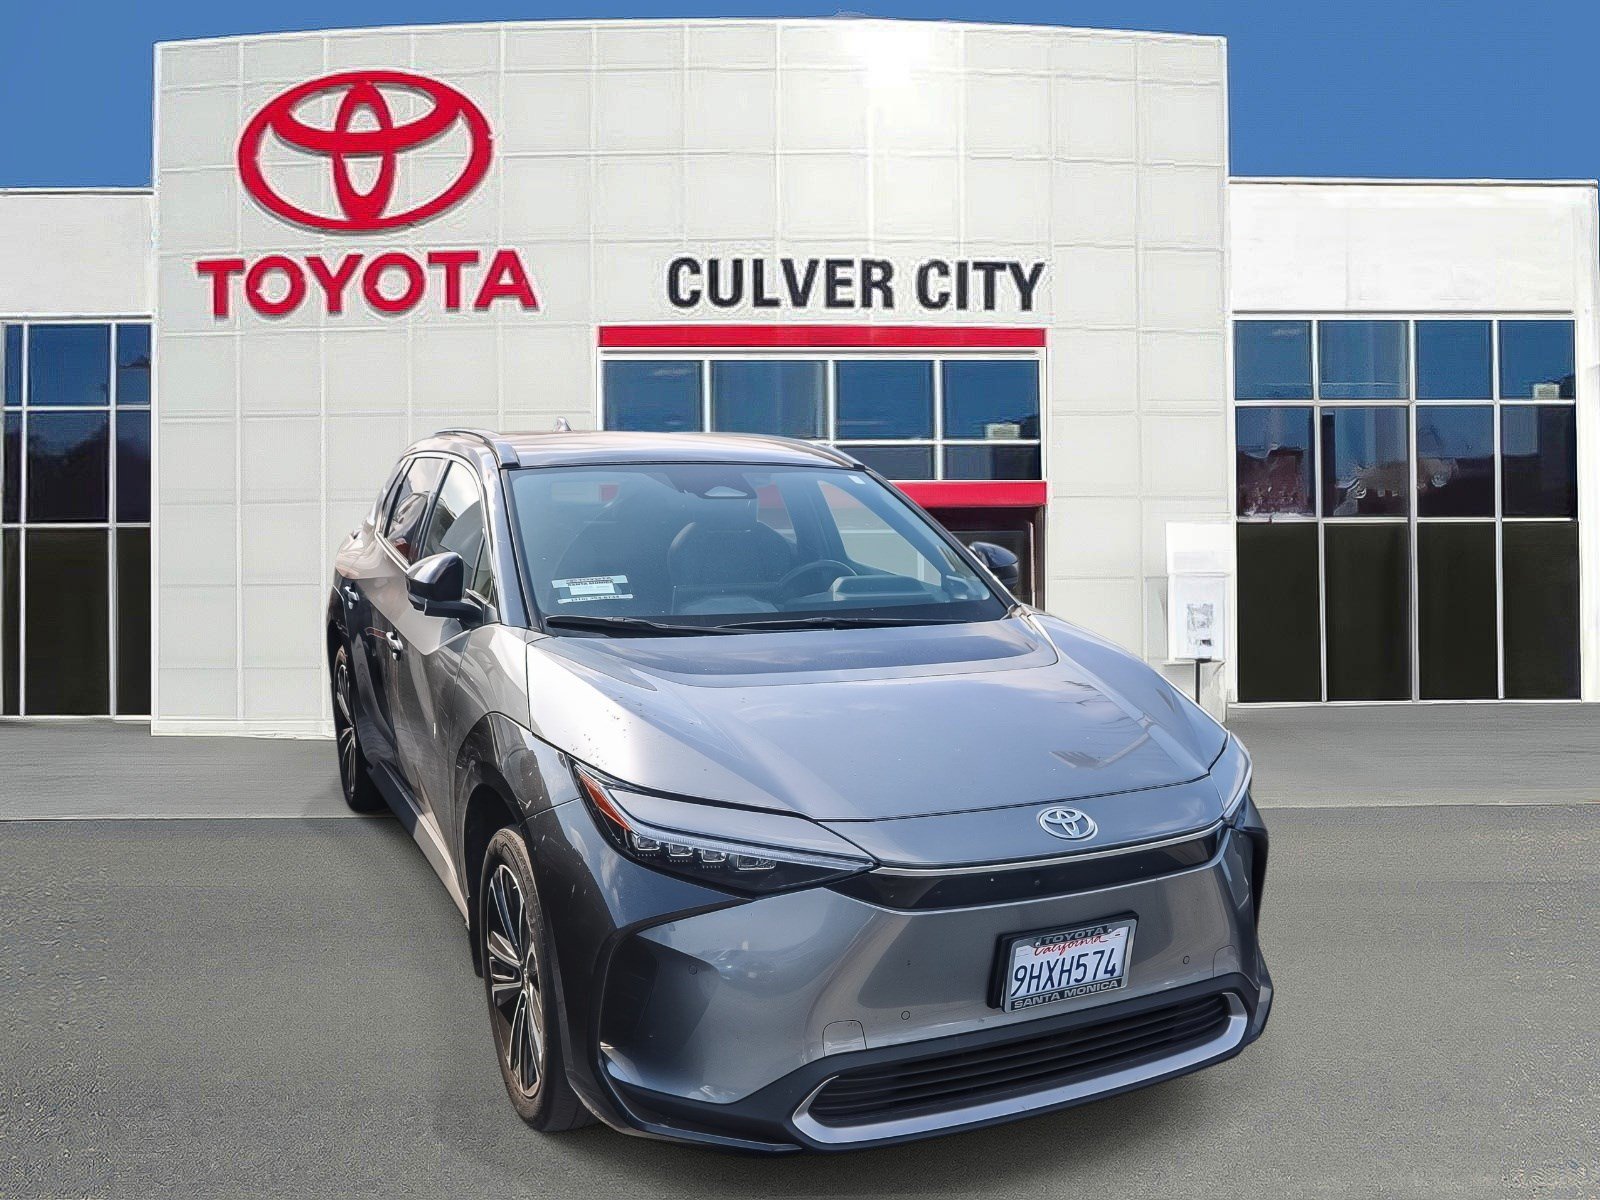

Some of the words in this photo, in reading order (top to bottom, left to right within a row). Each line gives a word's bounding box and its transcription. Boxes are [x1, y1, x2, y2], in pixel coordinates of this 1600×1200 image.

[196, 249, 539, 318] TOYOTA
[668, 258, 895, 309] CULVER
[915, 260, 1046, 311] CITY
[1034, 934, 1108, 957] California
[1043, 926, 1105, 943] TOYOTA
[1010, 947, 1117, 997] 9HXH574
[1013, 993, 1061, 1010] SANTA
[1064, 979, 1119, 998] MONICA
